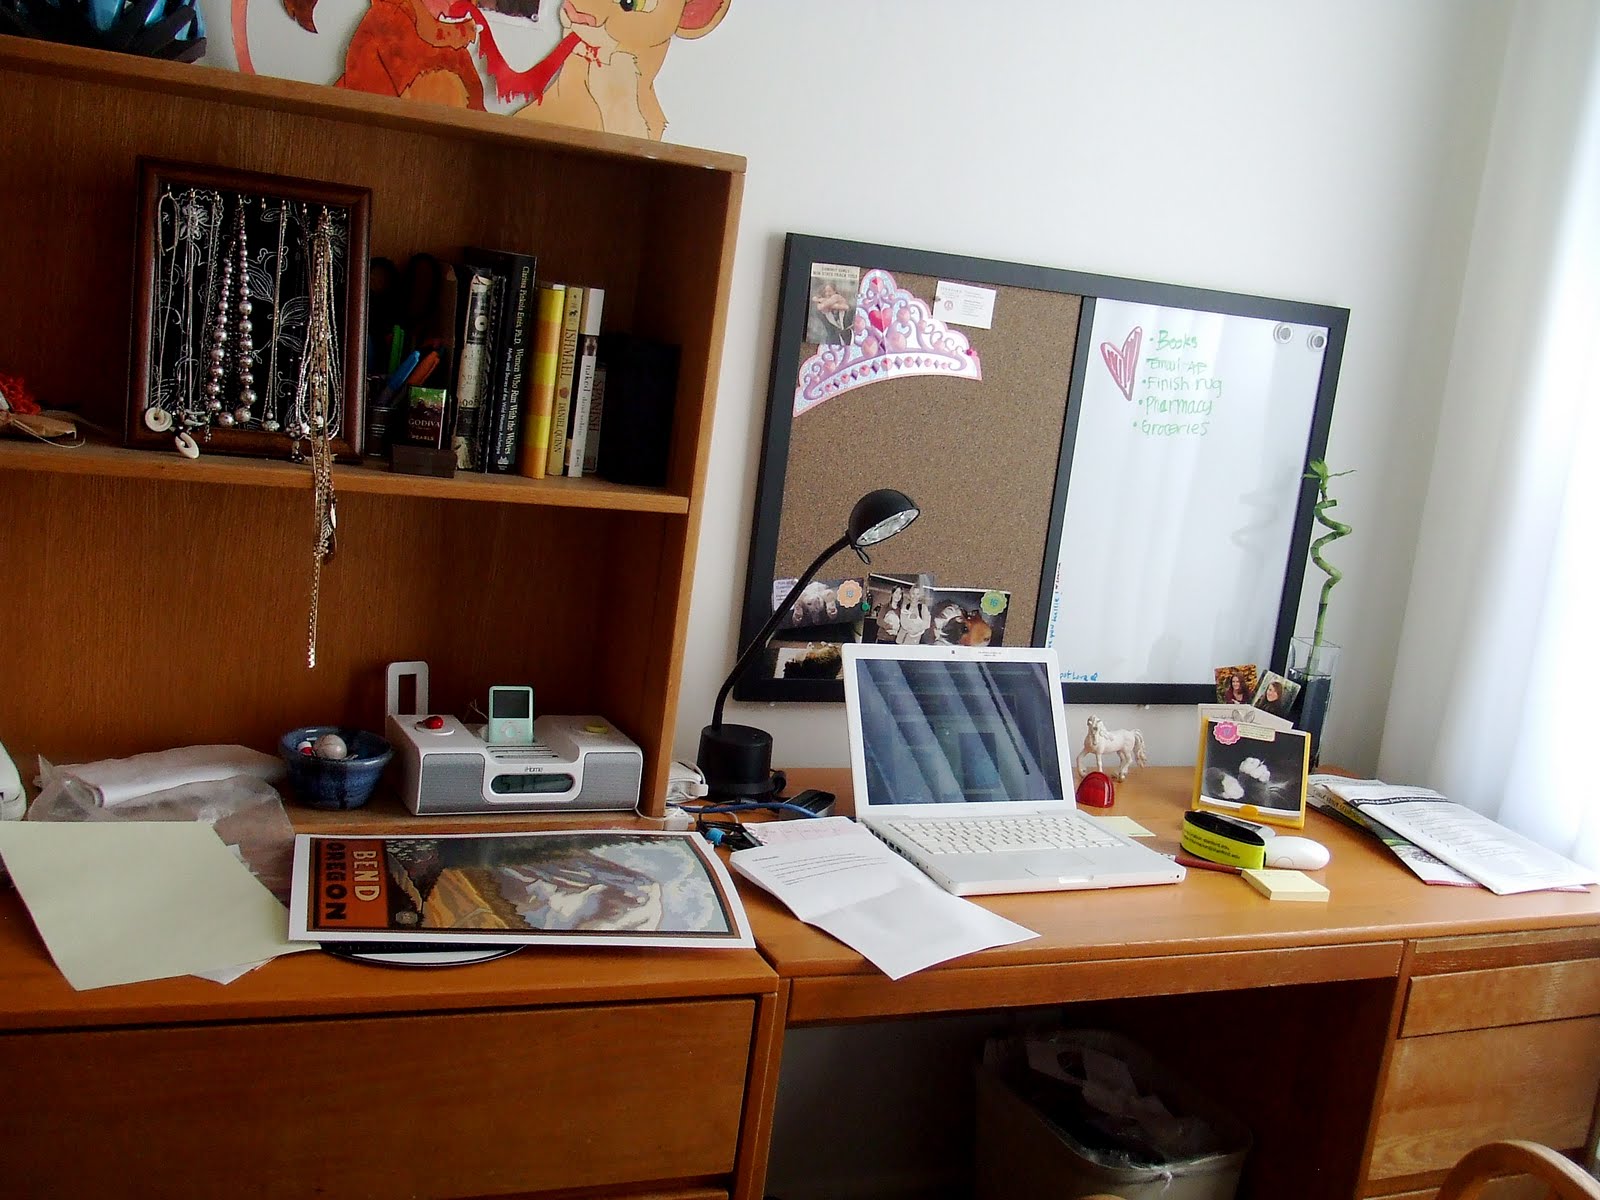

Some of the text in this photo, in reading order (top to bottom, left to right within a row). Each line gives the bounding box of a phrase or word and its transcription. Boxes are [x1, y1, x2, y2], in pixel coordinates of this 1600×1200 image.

[513, 329, 522, 345] Ph.D.
[1156, 330, 1198, 350] Books
[560, 328, 577, 379] ISHMAEL
[583, 364, 592, 392] naked
[1147, 376, 1223, 398] Finish rug
[504, 348, 524, 454] Women Who Run With the Wolves
[588, 380, 603, 432] SPANISH
[1145, 396, 1213, 416] Pharmacy
[408, 418, 440, 428] GODIVA
[554, 402, 566, 453] DANIEL QUINN
[1141, 419, 1211, 436] Groceries
[325, 842, 348, 920] OREGON
[353, 850, 381, 902] BEND
